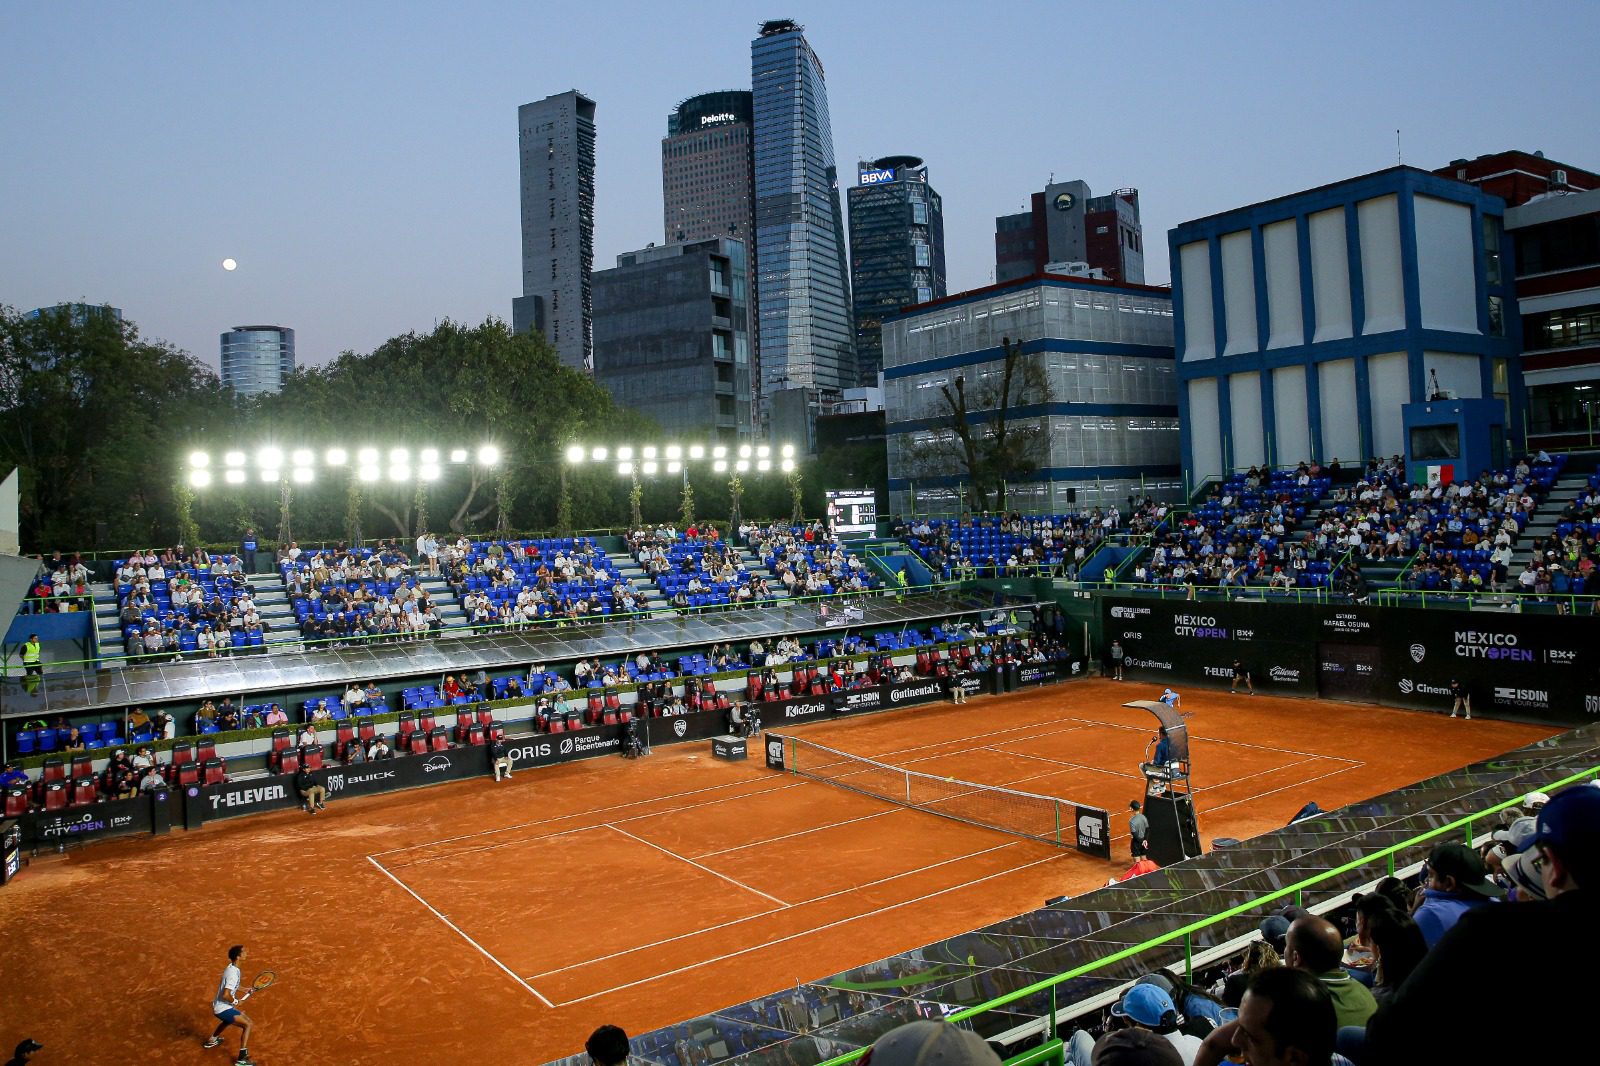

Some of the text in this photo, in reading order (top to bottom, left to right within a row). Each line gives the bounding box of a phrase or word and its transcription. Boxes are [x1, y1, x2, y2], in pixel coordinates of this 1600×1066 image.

[861, 170, 892, 184] BBVA
[1174, 614, 1216, 626] MEXICO
[1324, 619, 1347, 627] RAFAEL
[1123, 632, 1142, 640] ORIS
[1174, 626, 1197, 636] CITY
[1236, 629, 1254, 638] BX+
[1454, 630, 1518, 646] MEXICO
[1455, 644, 1489, 658] CITY
[1550, 650, 1576, 660] BX+
[1204, 666, 1234, 678] 7-ELEVE
[1356, 664, 1373, 672] BX+
[860, 692, 880, 702] ISDIN
[890, 684, 935, 702] Continental
[1516, 689, 1548, 702] ISDIN
[785, 702, 826, 718] KidZania
[574, 735, 601, 744] Parque
[575, 738, 620, 752] Bicentenario
[508, 744, 551, 761] ORIS
[348, 770, 396, 784] BUICK
